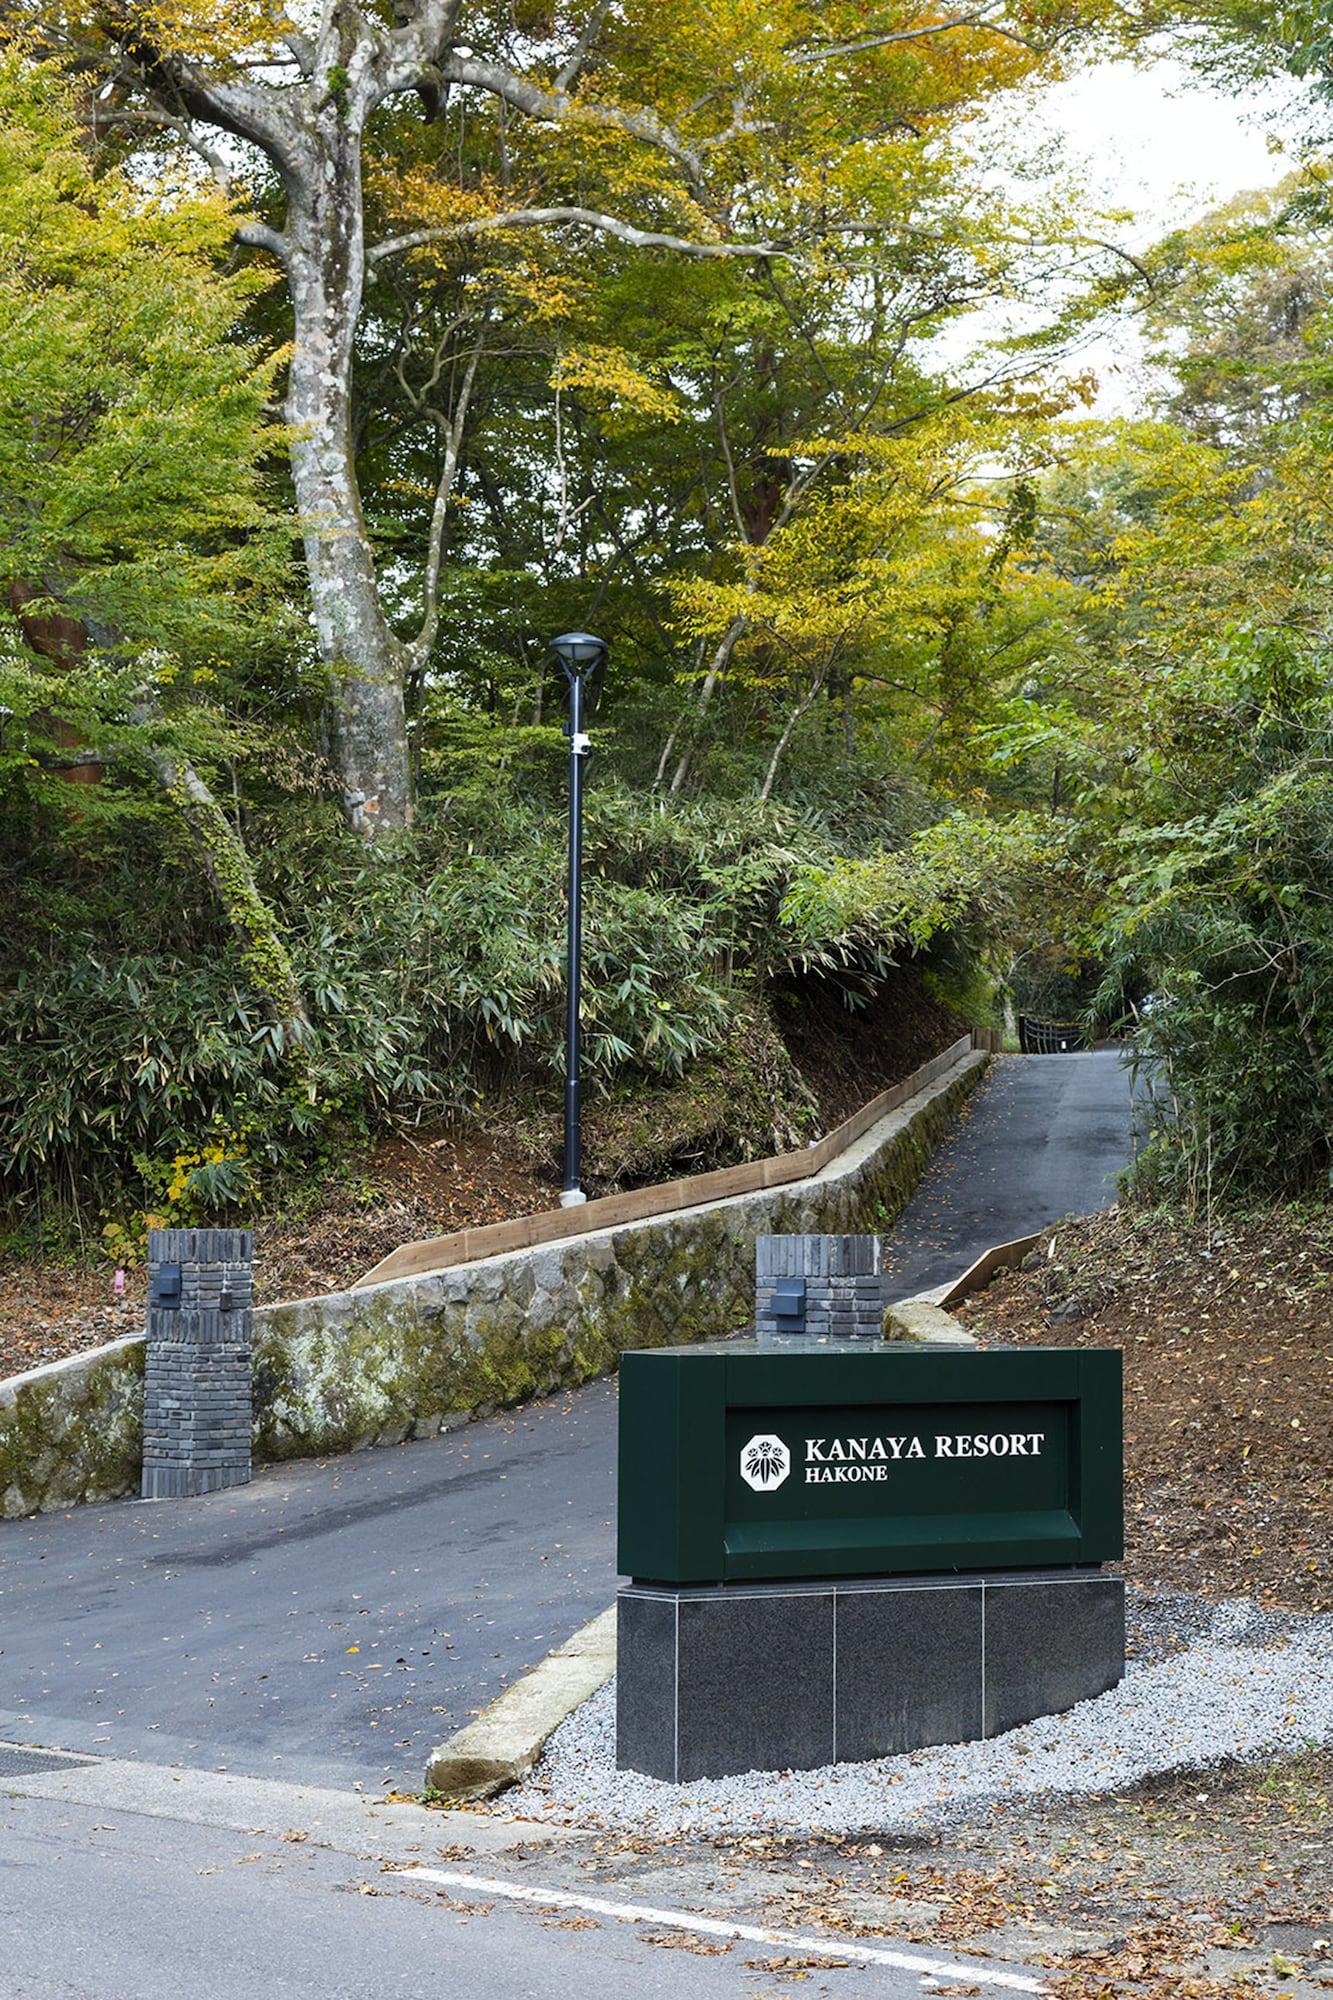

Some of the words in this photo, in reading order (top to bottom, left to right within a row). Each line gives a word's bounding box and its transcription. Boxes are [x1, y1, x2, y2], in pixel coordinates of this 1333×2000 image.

[804, 1436, 926, 1462] KANAYA
[935, 1433, 1045, 1458] RESORT
[804, 1465, 888, 1484] HAKONE
